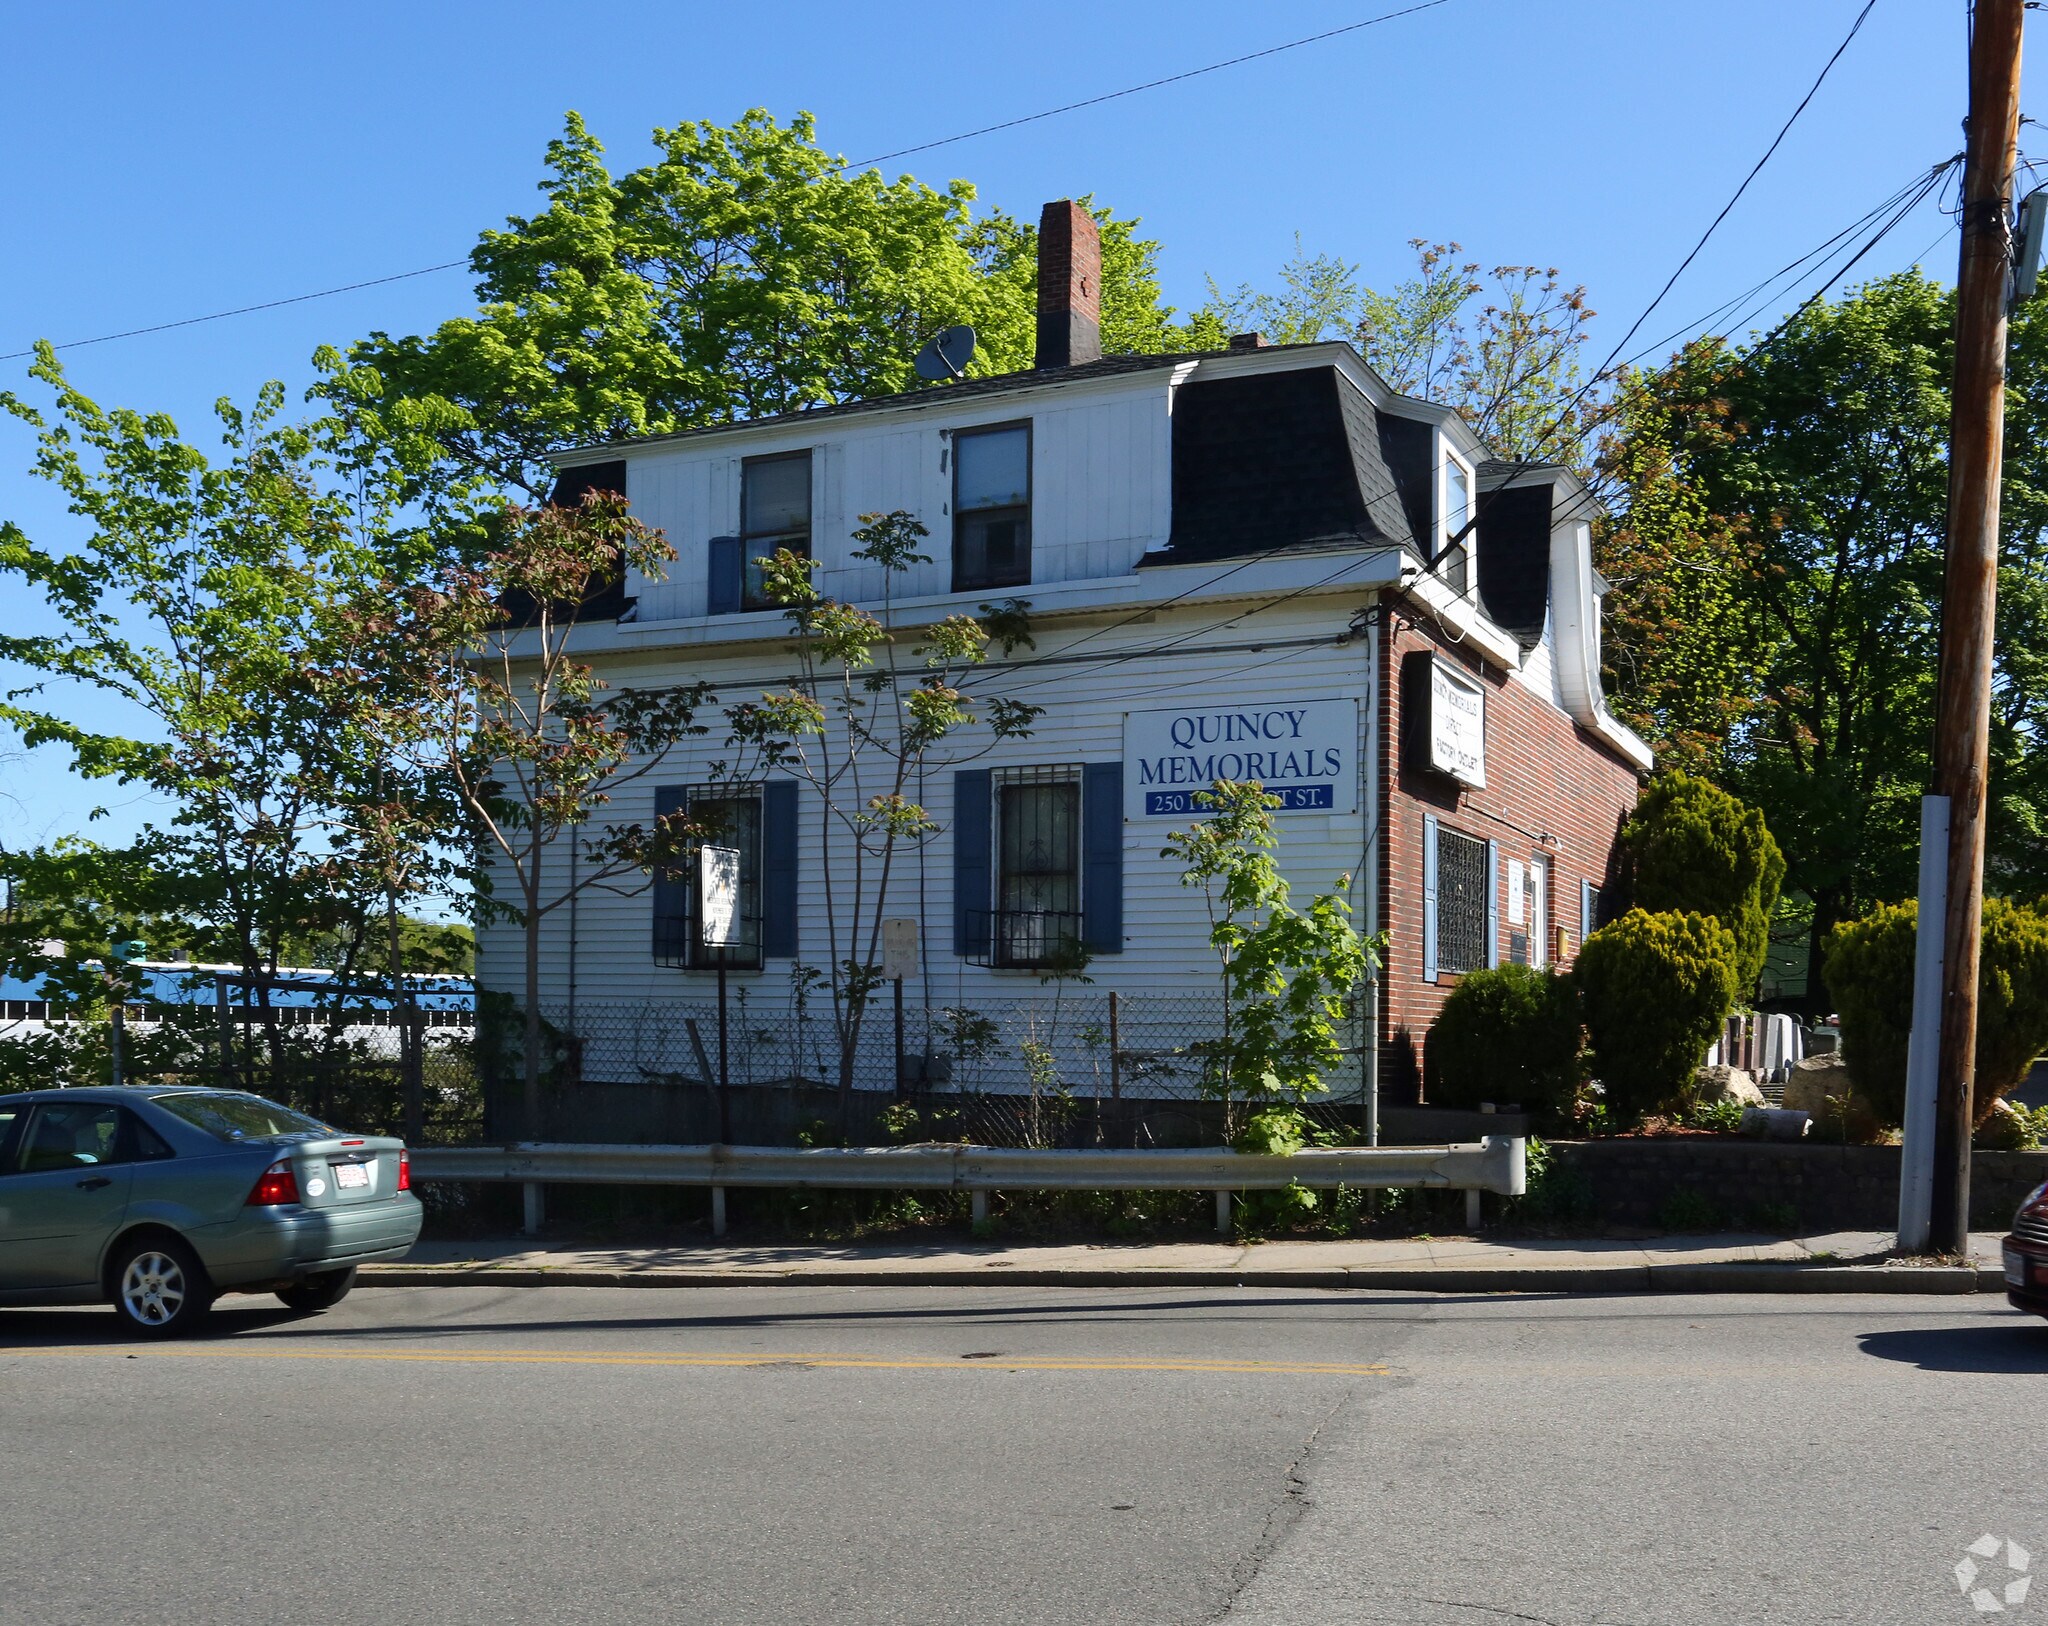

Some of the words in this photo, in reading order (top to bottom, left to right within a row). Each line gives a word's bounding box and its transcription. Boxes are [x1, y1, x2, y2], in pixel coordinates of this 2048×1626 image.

[1171, 710, 1307, 749] QUINCY
[1138, 748, 1341, 785] MEMORIALS
[1154, 794, 1184, 812] 250
[1295, 788, 1324, 806] ST.
